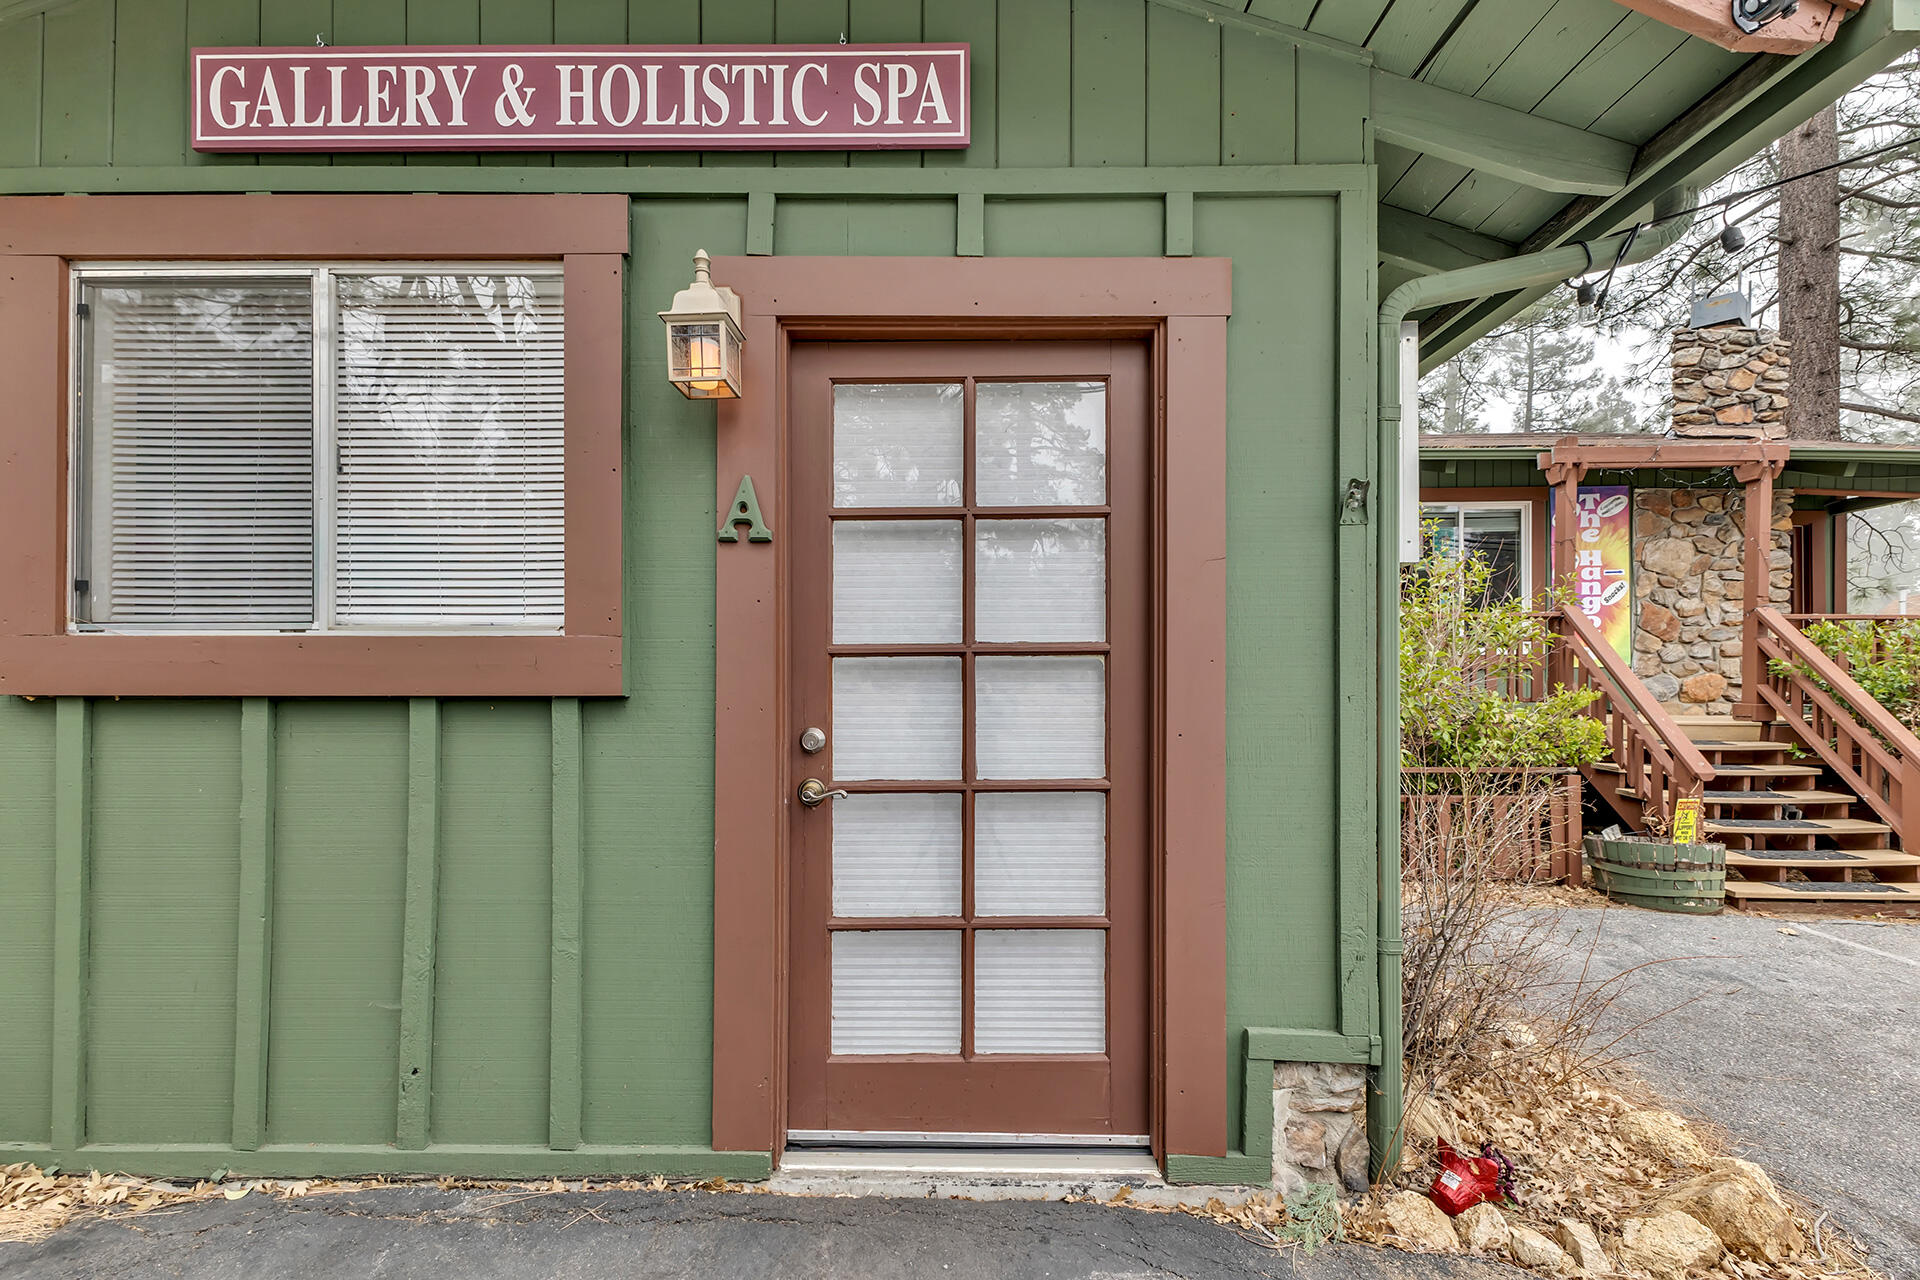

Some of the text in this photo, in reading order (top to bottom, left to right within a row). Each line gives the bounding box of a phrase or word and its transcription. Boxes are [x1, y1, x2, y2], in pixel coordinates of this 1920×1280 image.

[209, 62, 953, 129] GALLERY & HOLISTIC SPA
[718, 475, 773, 543] A
[1578, 493, 1601, 543] The
[1604, 582, 1625, 603] Snacks!
